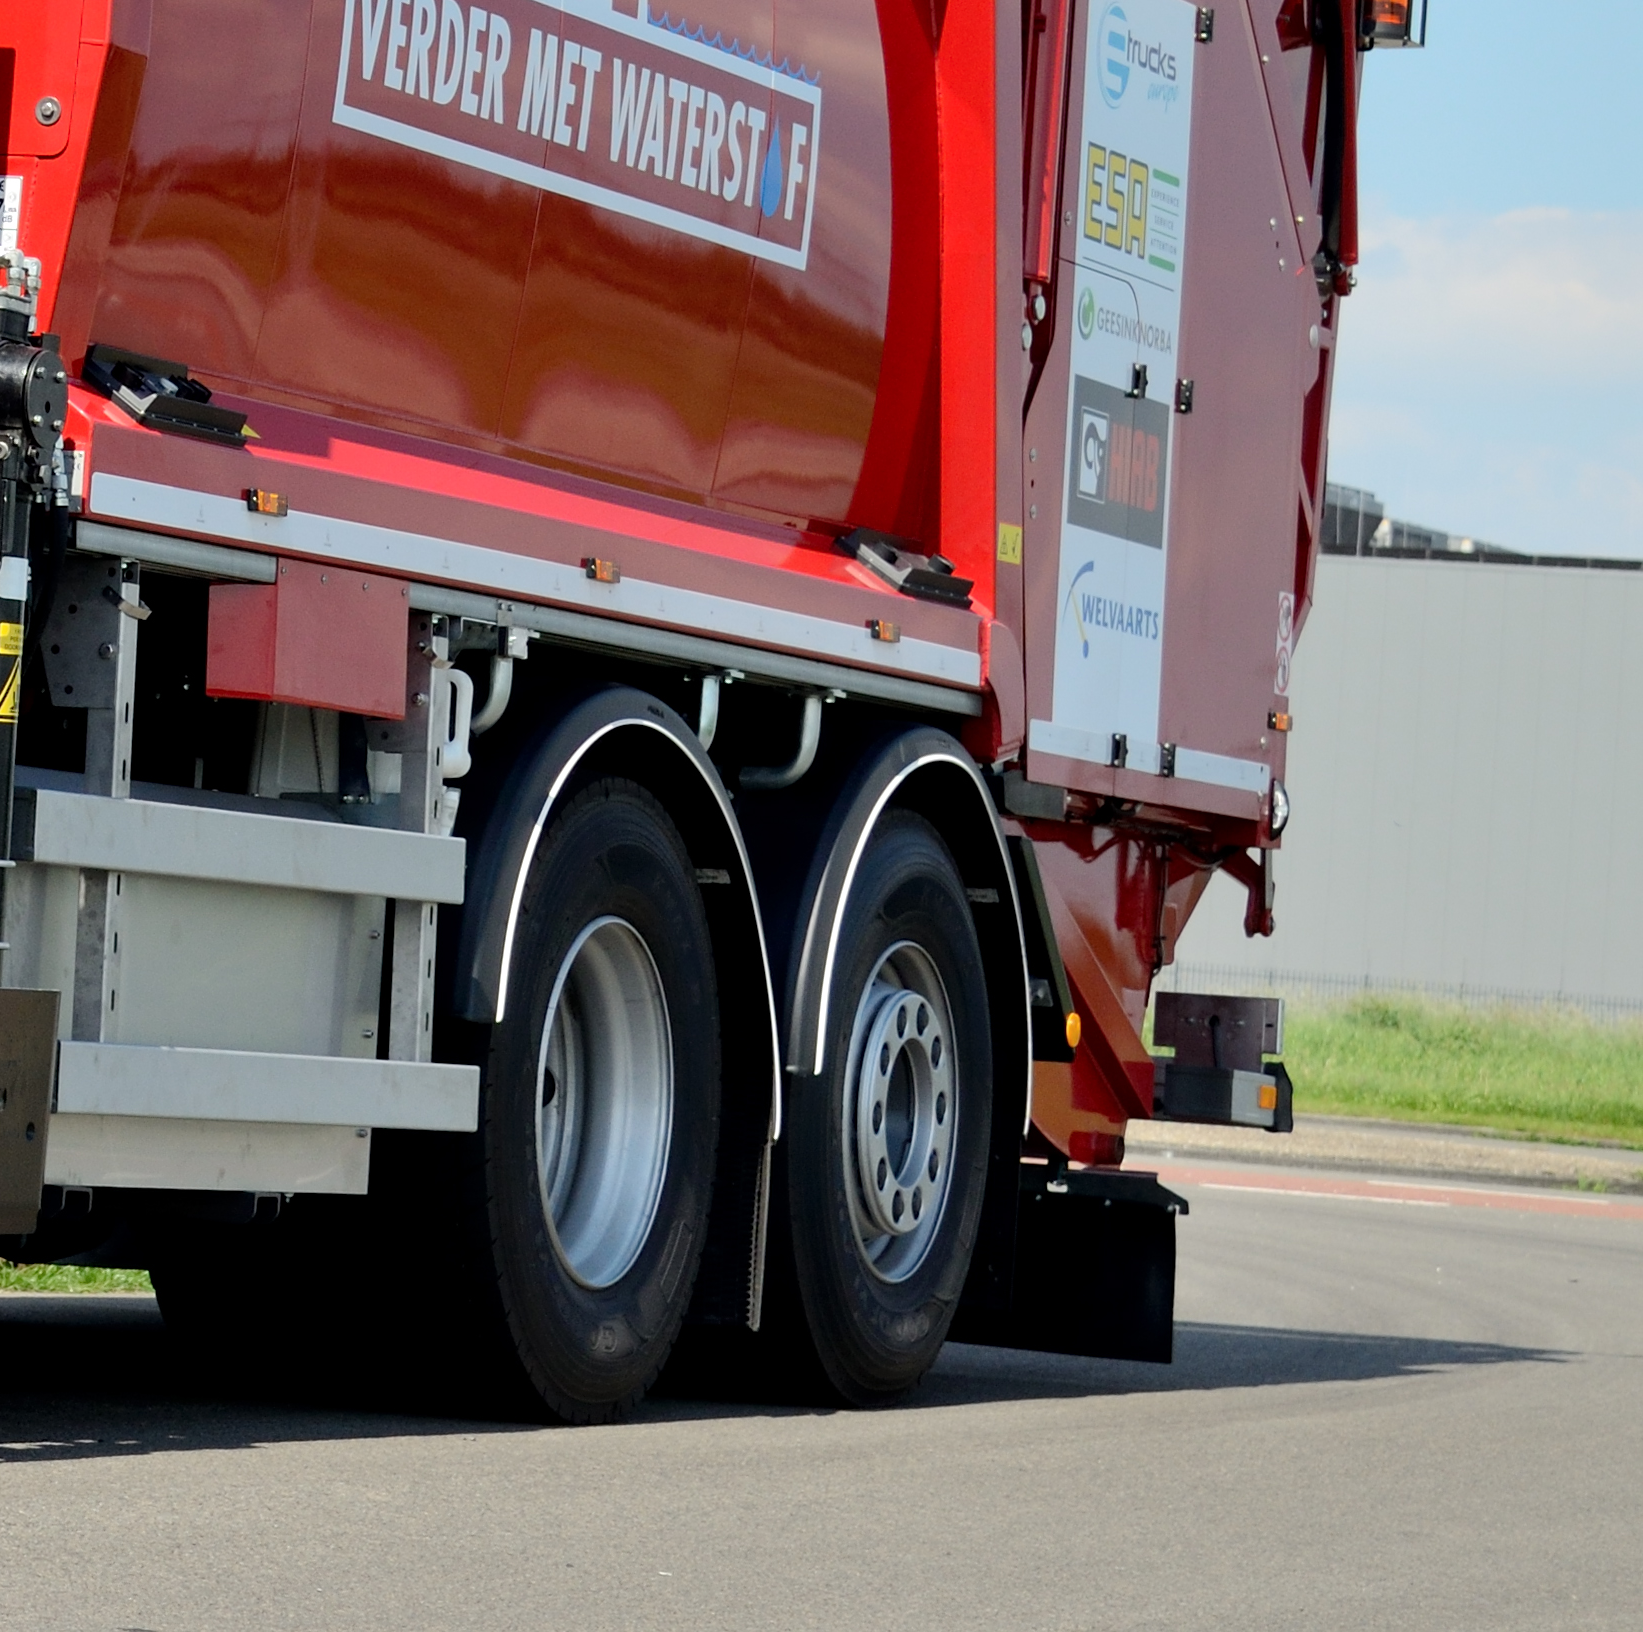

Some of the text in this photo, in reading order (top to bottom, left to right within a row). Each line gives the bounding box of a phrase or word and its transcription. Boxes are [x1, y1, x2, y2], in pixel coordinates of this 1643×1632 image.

[517, 27, 602, 152] MET
[1083, 141, 1149, 260] ESA
[1151, 188, 1180, 208] EXPERIENCE
[1150, 238, 1177, 256] ATTENTION
[1097, 307, 1172, 355] GEESINKNORBA
[1108, 421, 1160, 513] HIAB
[1081, 592, 1159, 641] WELVAARTS
